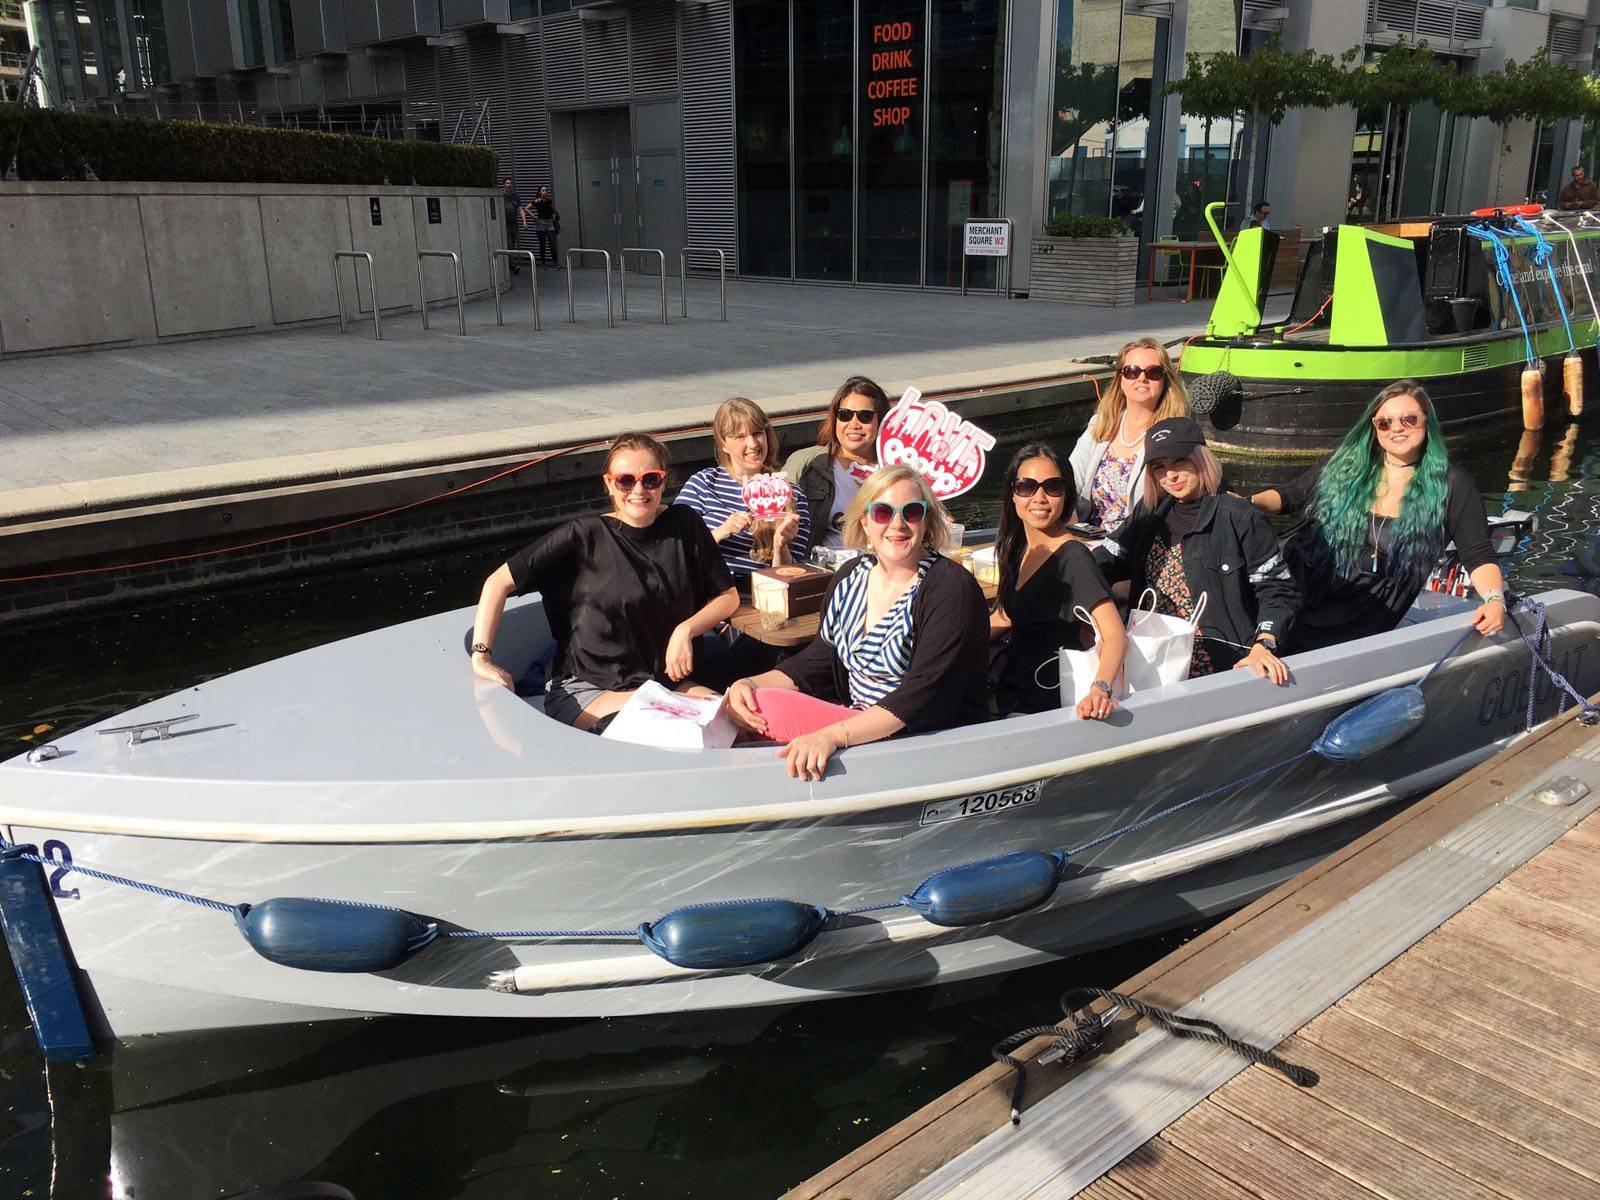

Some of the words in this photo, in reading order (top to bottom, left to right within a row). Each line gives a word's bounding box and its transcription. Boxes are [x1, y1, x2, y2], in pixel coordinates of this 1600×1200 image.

[874, 22, 912, 43] FOOD
[872, 48, 912, 72] DRINK
[867, 77, 918, 99] COFFEE
[873, 106, 910, 126] SHOP
[968, 226, 1003, 235] MERCHANT
[968, 236, 993, 245] SQUARE
[994, 236, 1005, 246] W2
[1496, 270, 1519, 286] Ce
[1520, 265, 1535, 283] and
[1536, 266, 1562, 284] expre
[1562, 259, 1575, 277] the
[958, 784, 1037, 815] 120568
